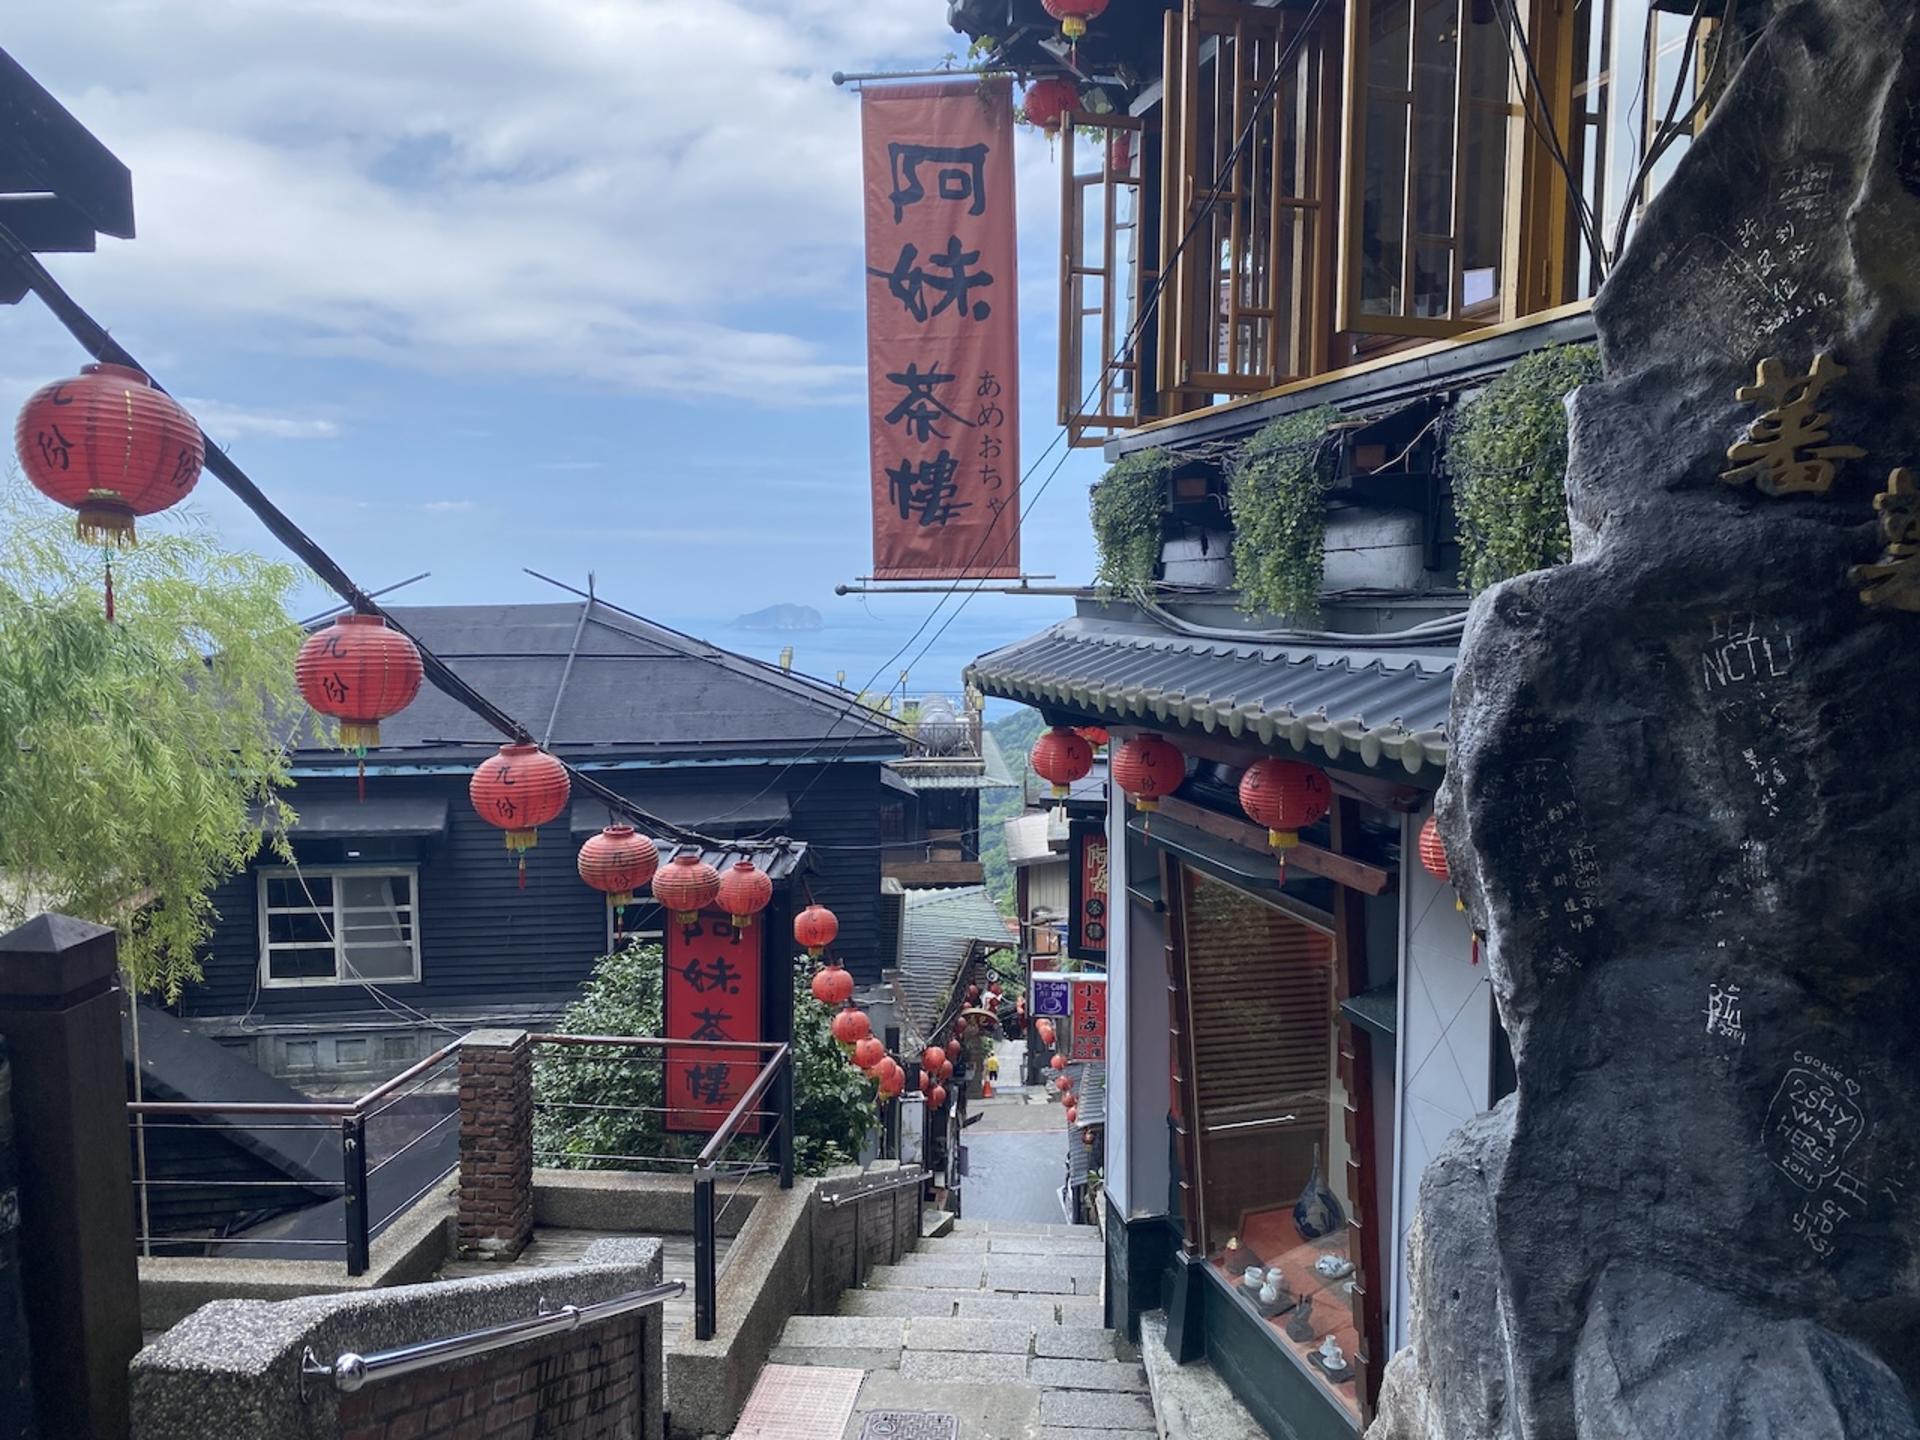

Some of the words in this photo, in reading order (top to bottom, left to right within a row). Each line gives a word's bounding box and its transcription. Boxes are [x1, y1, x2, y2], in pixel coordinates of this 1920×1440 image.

[867, 142, 994, 526] 阿妹茶樓
[976, 369, 1005, 515] あめおちゃ
[321, 636, 350, 703] 九份
[496, 766, 517, 819] 九份
[1792, 1105, 1837, 1148] WAS
